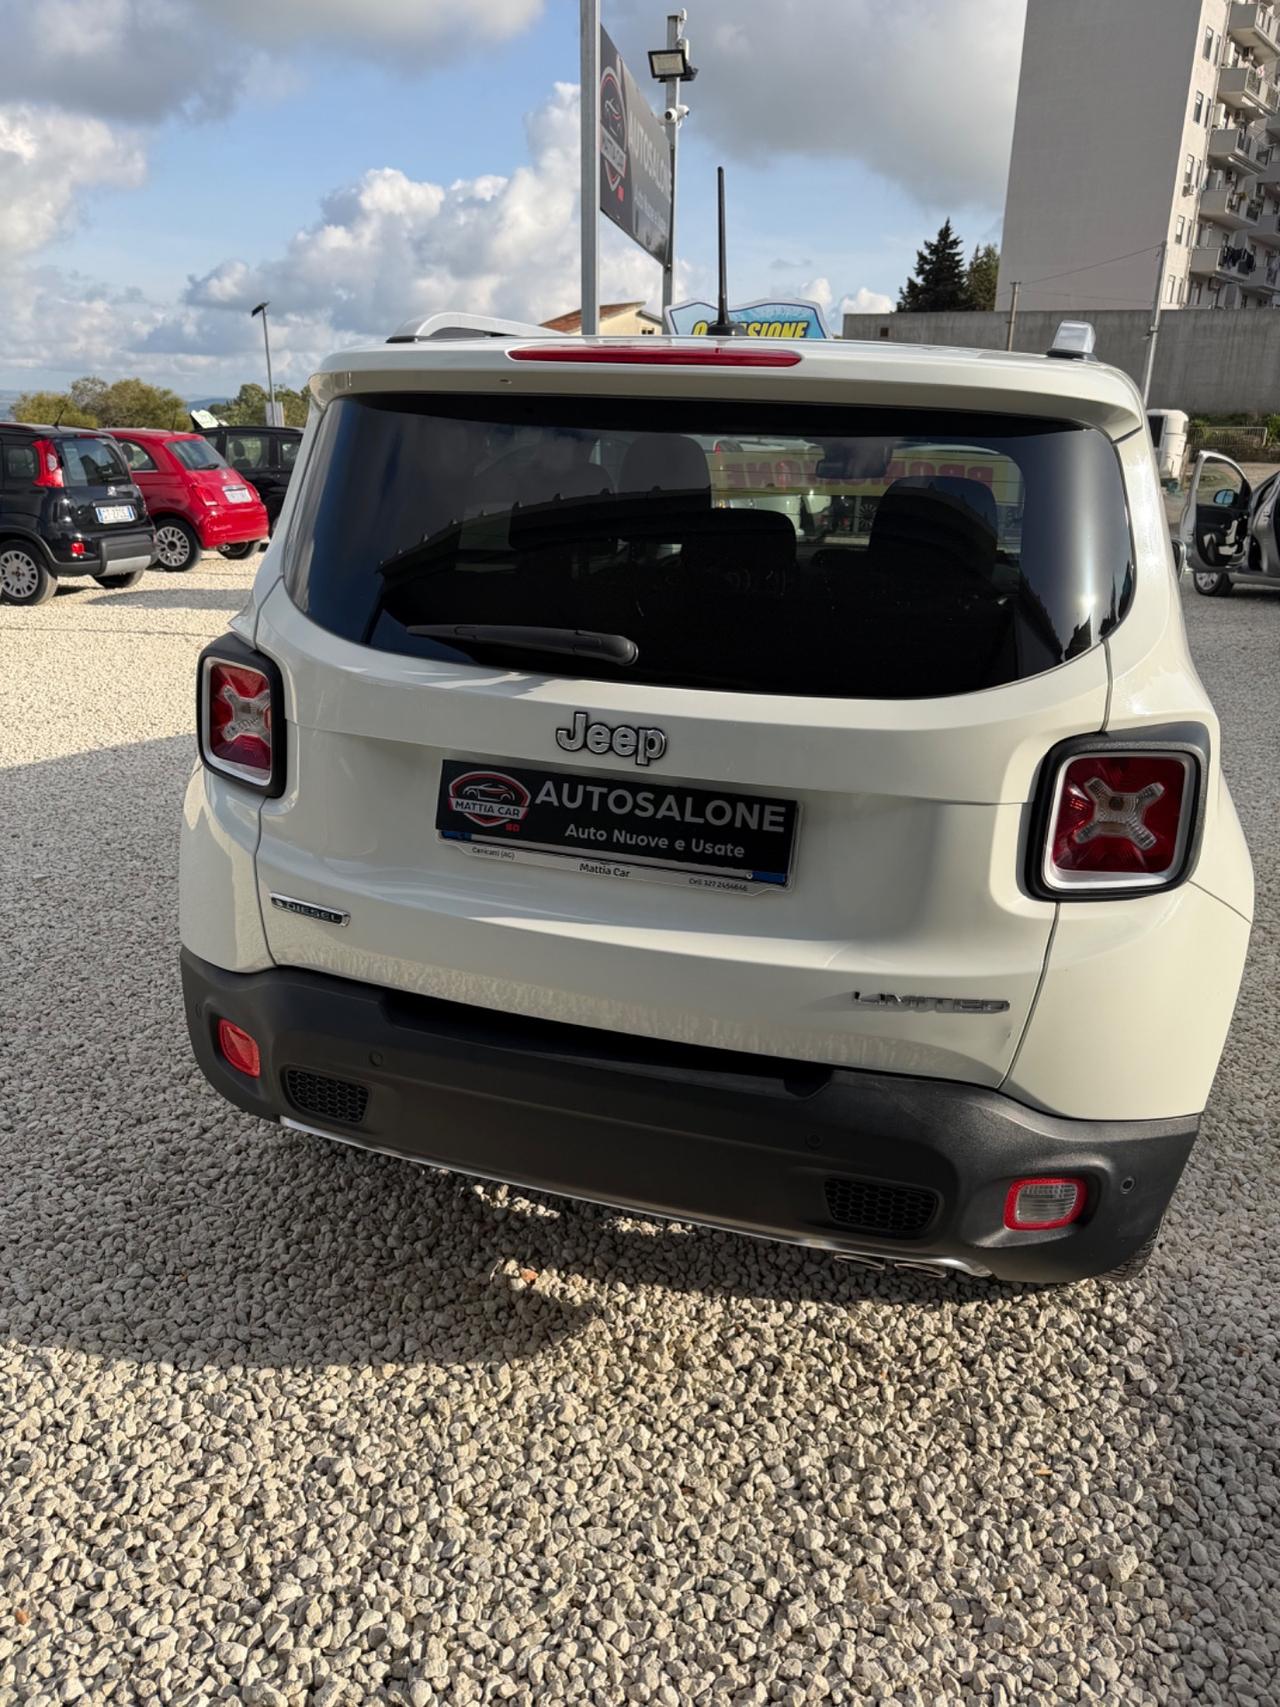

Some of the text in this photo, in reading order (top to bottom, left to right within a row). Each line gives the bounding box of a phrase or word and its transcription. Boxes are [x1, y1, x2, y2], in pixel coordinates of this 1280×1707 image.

[692, 319, 808, 339] OSIONE
[555, 711, 667, 767] Jeep
[454, 800, 521, 818] MATTIA CAR
[535, 780, 787, 833] AUTOSALONE
[564, 823, 745, 858] Auto Nuove e Usate
[579, 862, 631, 878] Mattia Car
